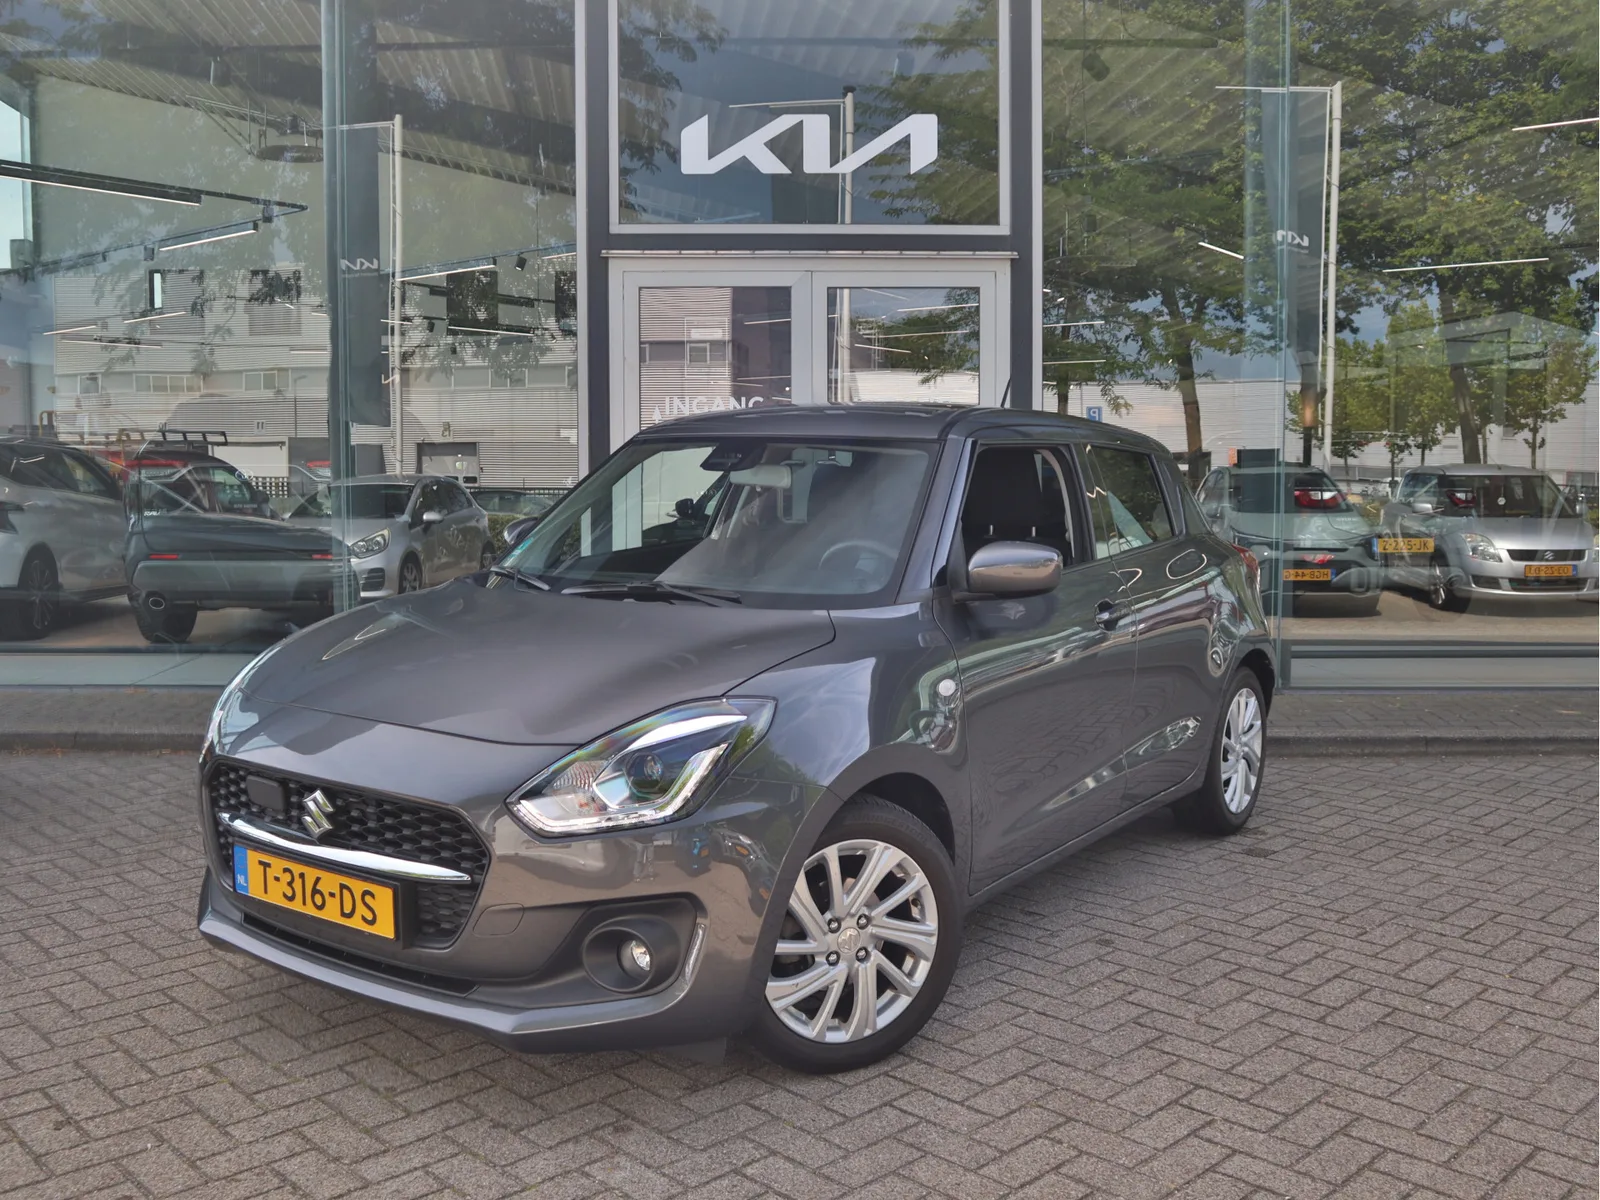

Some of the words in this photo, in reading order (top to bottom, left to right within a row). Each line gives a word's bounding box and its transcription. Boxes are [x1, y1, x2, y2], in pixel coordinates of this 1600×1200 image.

[681, 113, 938, 175] KIA
[1382, 539, 1430, 551] Z-225-JK
[236, 873, 248, 887] NL
[258, 859, 378, 927] T-316-DS
